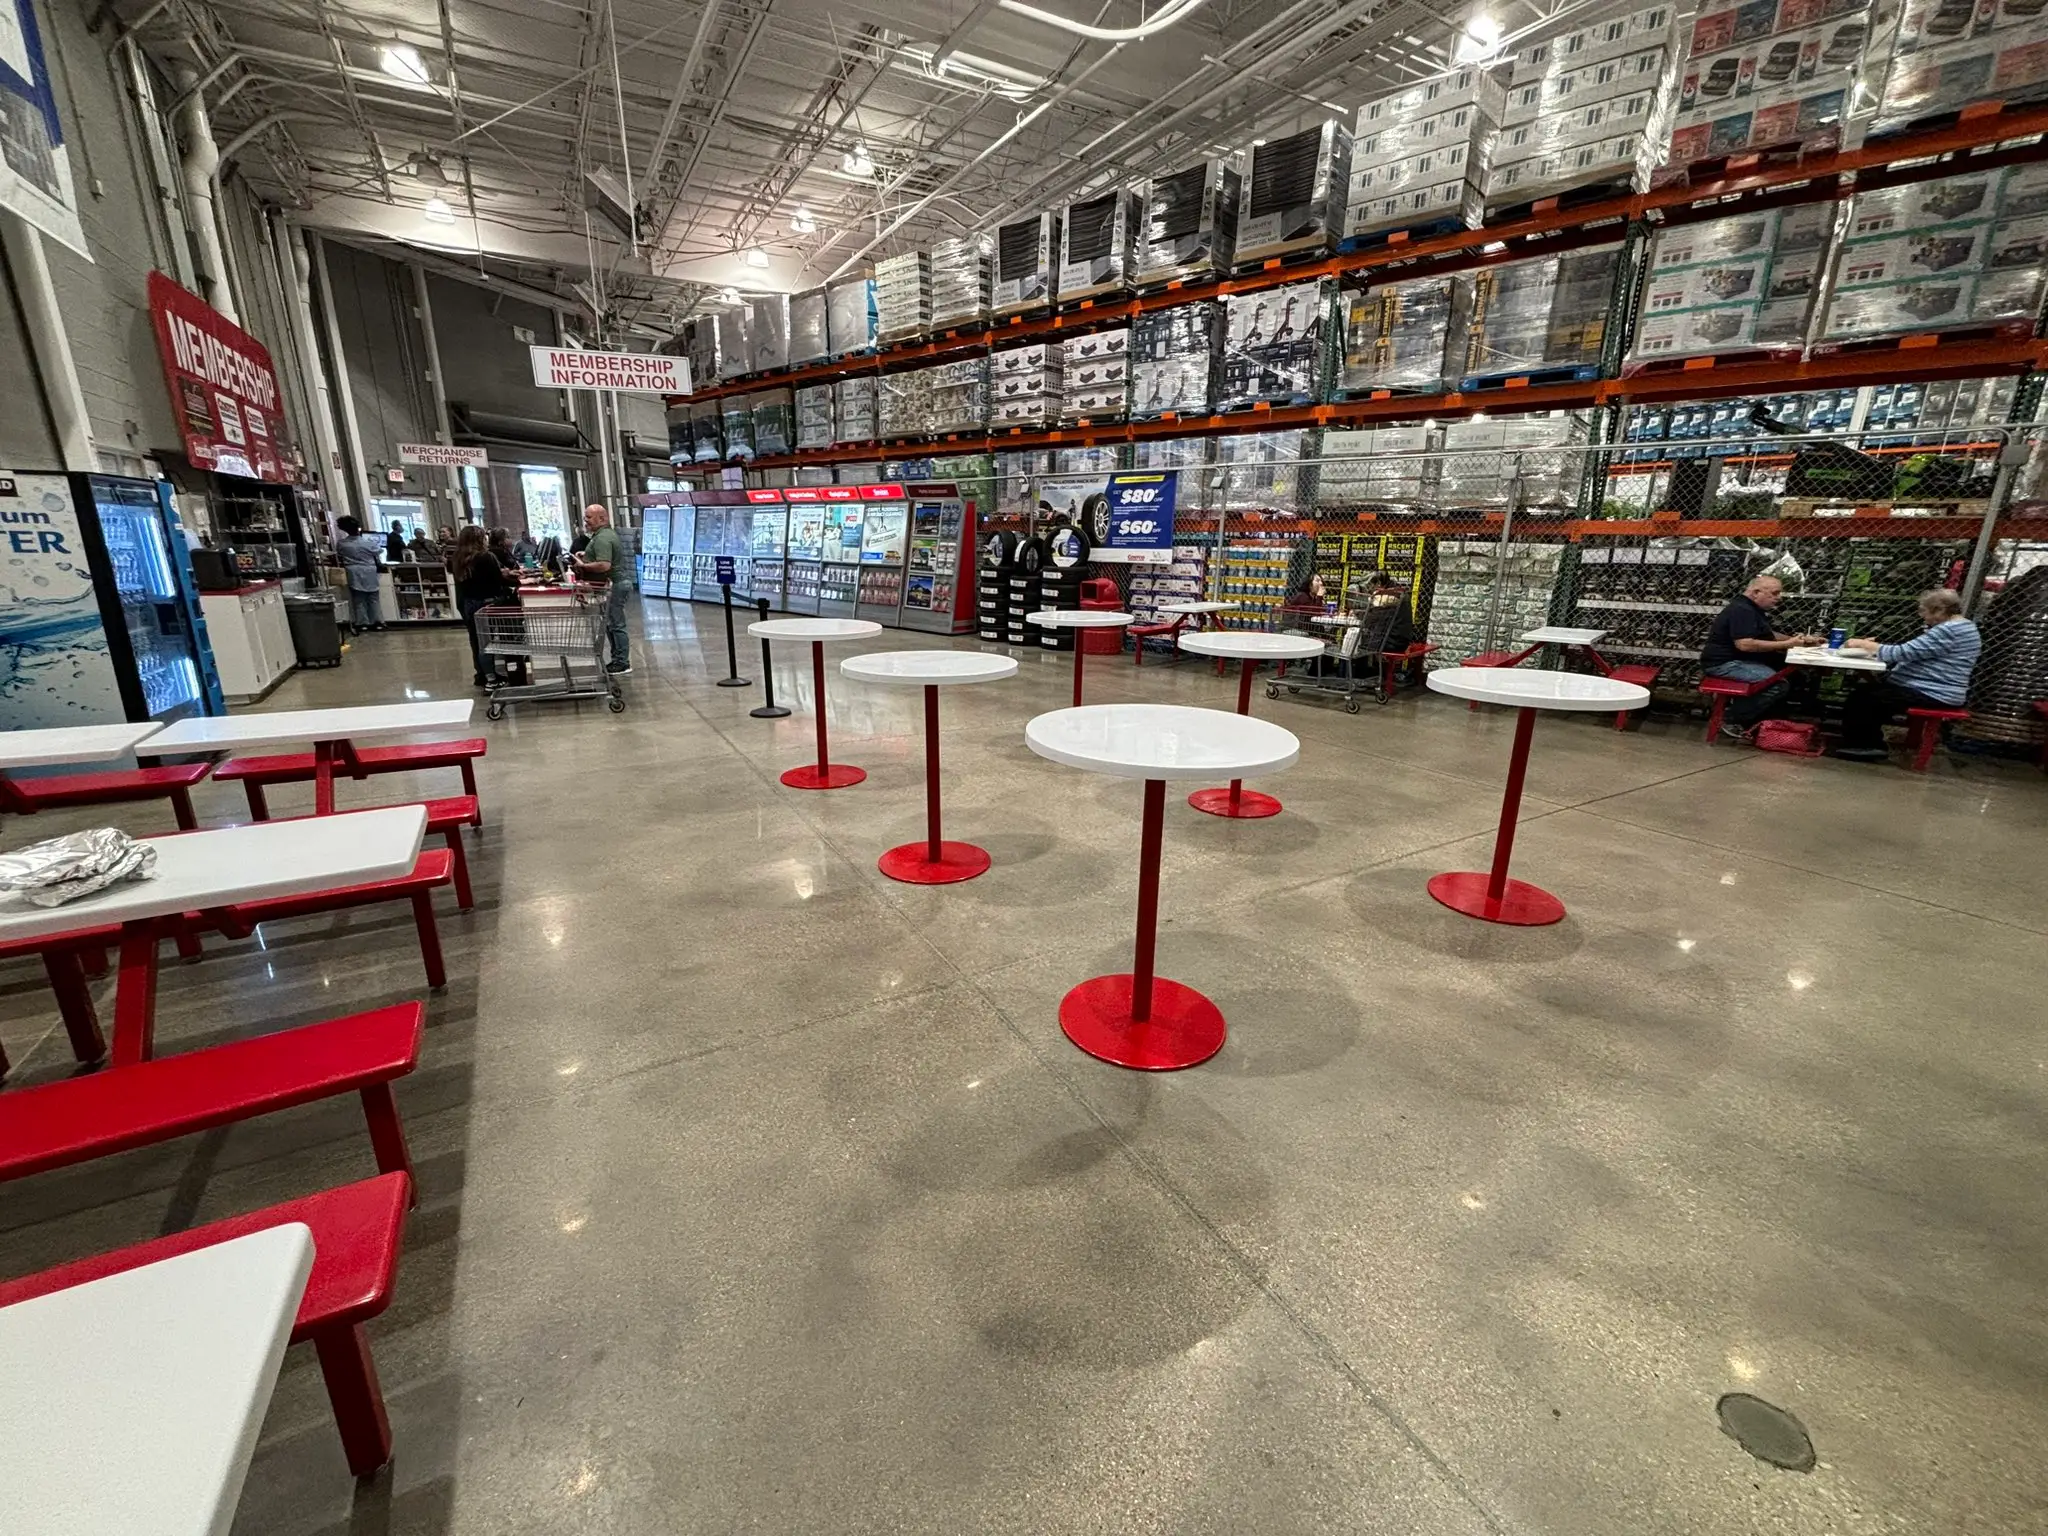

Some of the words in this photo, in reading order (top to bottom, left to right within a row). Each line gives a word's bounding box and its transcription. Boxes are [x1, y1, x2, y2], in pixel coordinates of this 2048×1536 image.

[166, 309, 275, 411] MEMBERSHIP
[550, 352, 673, 374] MEMBERSHIP
[551, 369, 677, 390] INFORMATION
[402, 446, 483, 458] MERCHANDISE
[418, 455, 471, 465] RETURNS
[390, 471, 402, 480] EXIT
[0, 480, 13, 490] D
[0, 511, 51, 524] um
